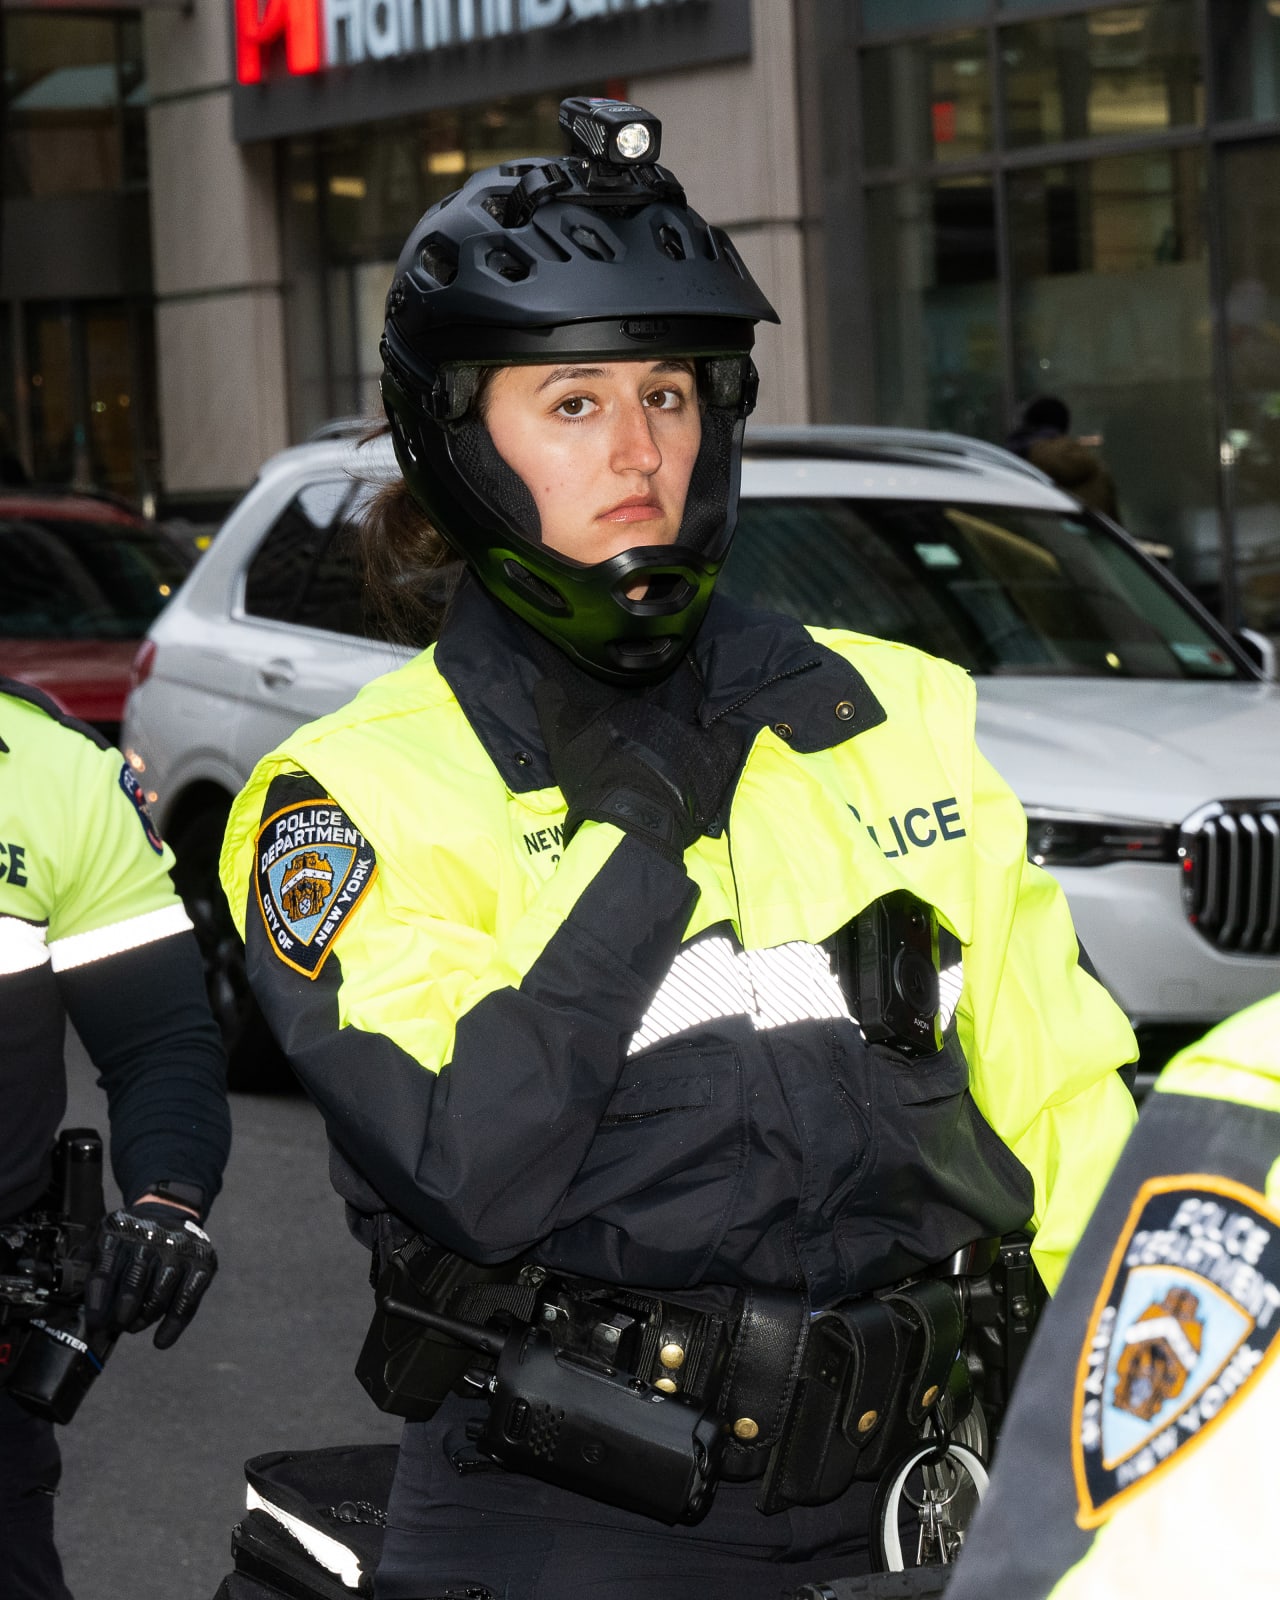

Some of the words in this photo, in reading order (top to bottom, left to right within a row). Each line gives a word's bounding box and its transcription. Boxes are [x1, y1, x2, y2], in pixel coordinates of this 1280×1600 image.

[276, 810, 342, 840] POLICE
[261, 826, 366, 875] DEPARTMENT
[262, 894, 281, 932] CITY
[277, 929, 294, 951] OF
[314, 906, 343, 947] NEW
[341, 857, 372, 904] YORK
